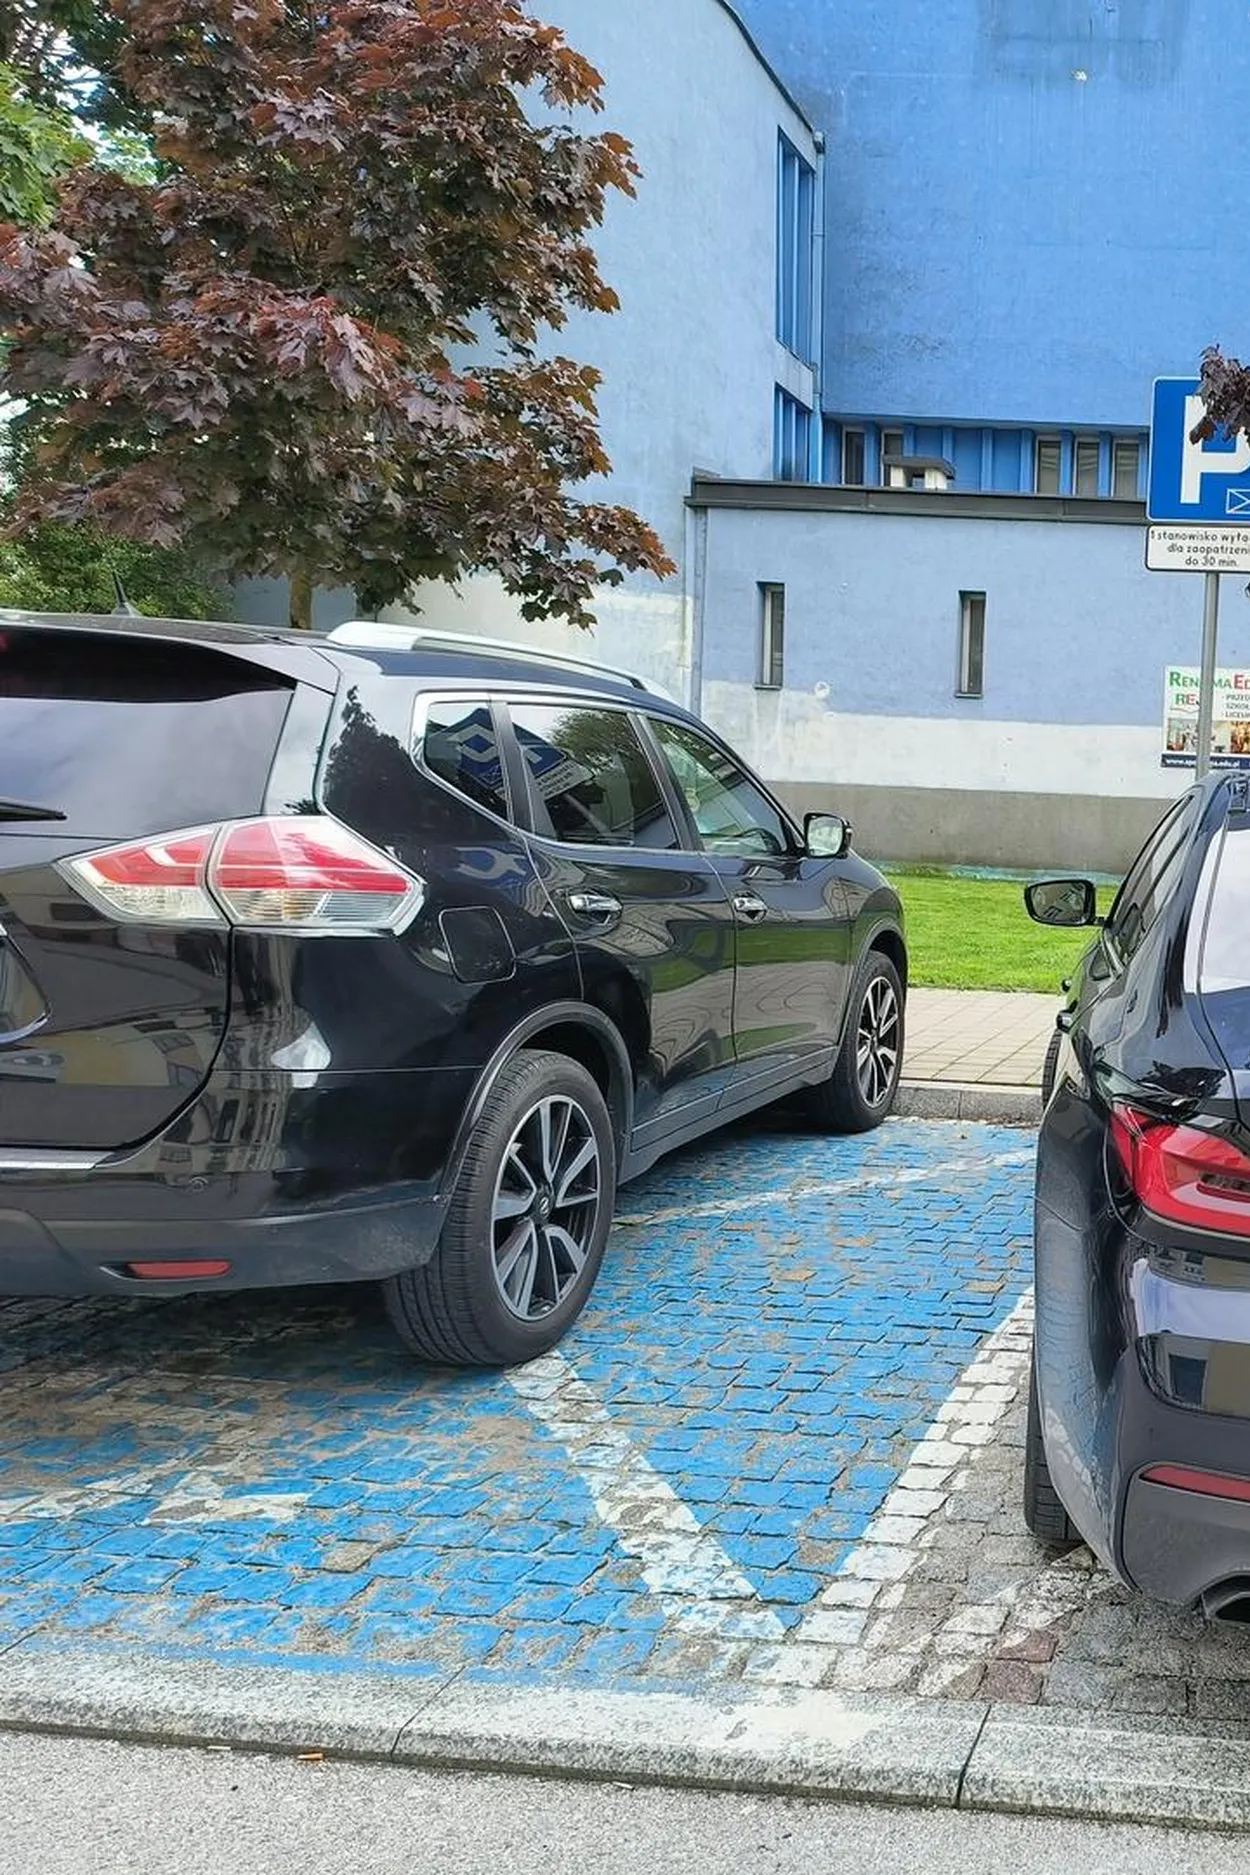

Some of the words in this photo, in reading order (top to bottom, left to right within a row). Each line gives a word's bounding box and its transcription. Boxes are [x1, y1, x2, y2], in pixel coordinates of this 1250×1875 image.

[1158, 530, 1218, 541] stanowisko
[1167, 543, 1184, 553] dla
[1185, 556, 1199, 566] do
[1201, 556, 1216, 566] 30
